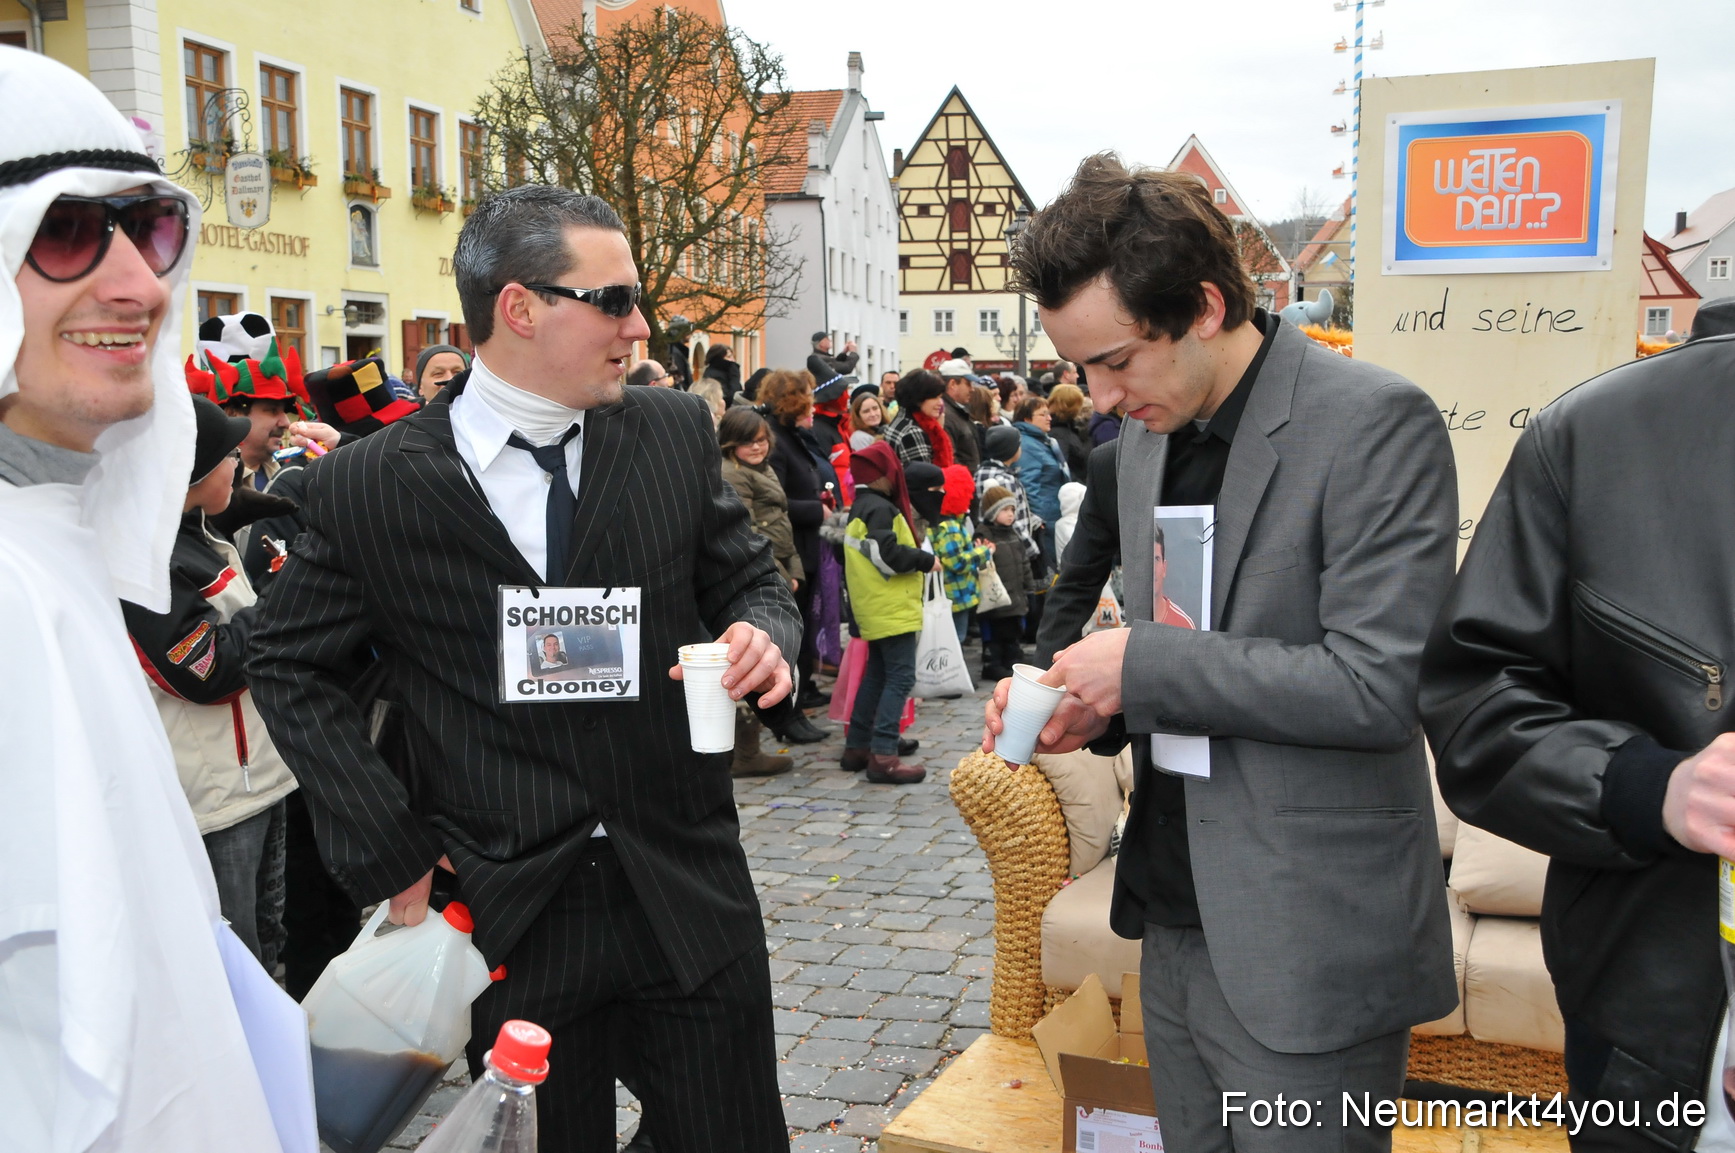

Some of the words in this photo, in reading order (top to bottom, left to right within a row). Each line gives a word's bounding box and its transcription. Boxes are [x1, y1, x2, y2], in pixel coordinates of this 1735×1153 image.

[233, 173, 262, 184] Gasthof
[1391, 287, 1449, 334] und
[1472, 302, 1584, 334] seine
[507, 605, 637, 626] SCHORSCH
[577, 635, 591, 644] VIP
[517, 679, 631, 696] Clooney
